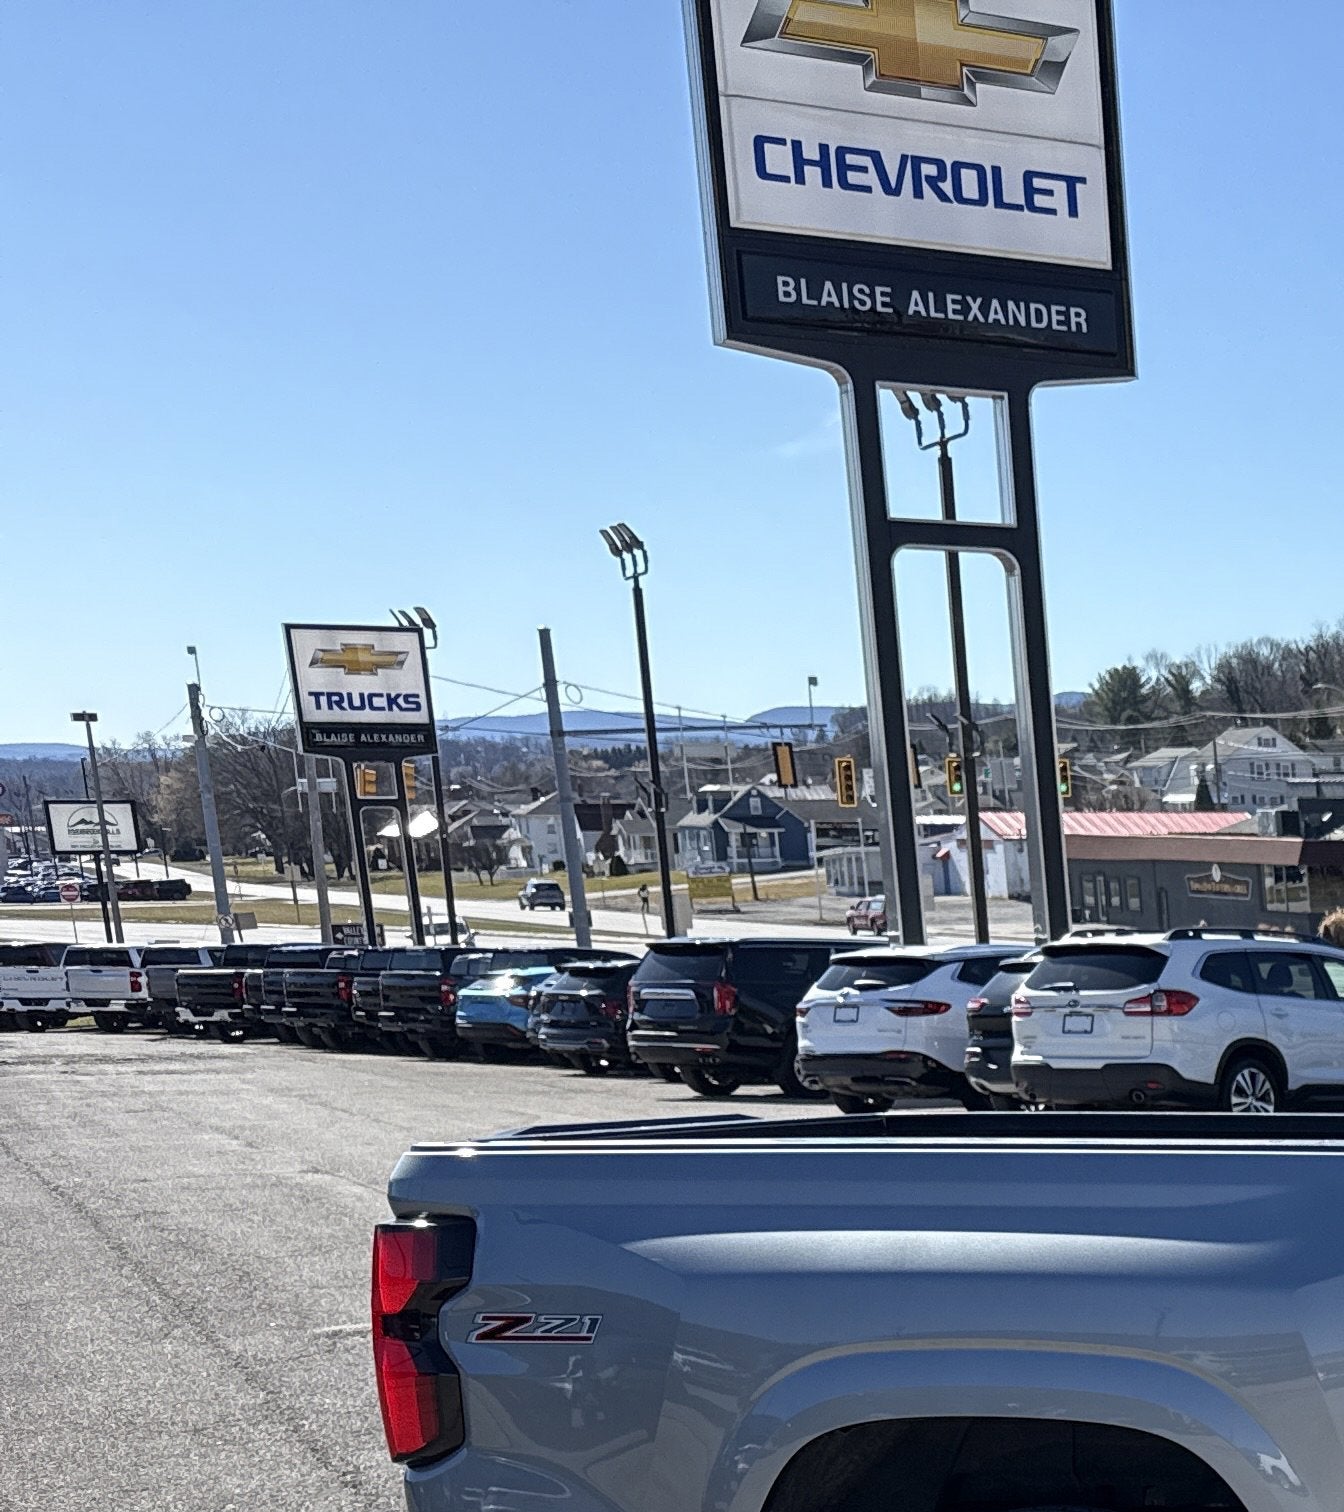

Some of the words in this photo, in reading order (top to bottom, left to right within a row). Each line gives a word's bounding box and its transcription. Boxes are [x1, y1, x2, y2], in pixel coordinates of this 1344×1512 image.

[753, 134, 1087, 219] CHEVROLET
[775, 275, 894, 315] BLAISE
[908, 289, 1088, 334] ALEXANDER
[308, 691, 422, 712] TRUCKS
[315, 732, 355, 743] BLAISE
[360, 733, 425, 744] ALEXANDER
[466, 1312, 603, 1345] Z71
